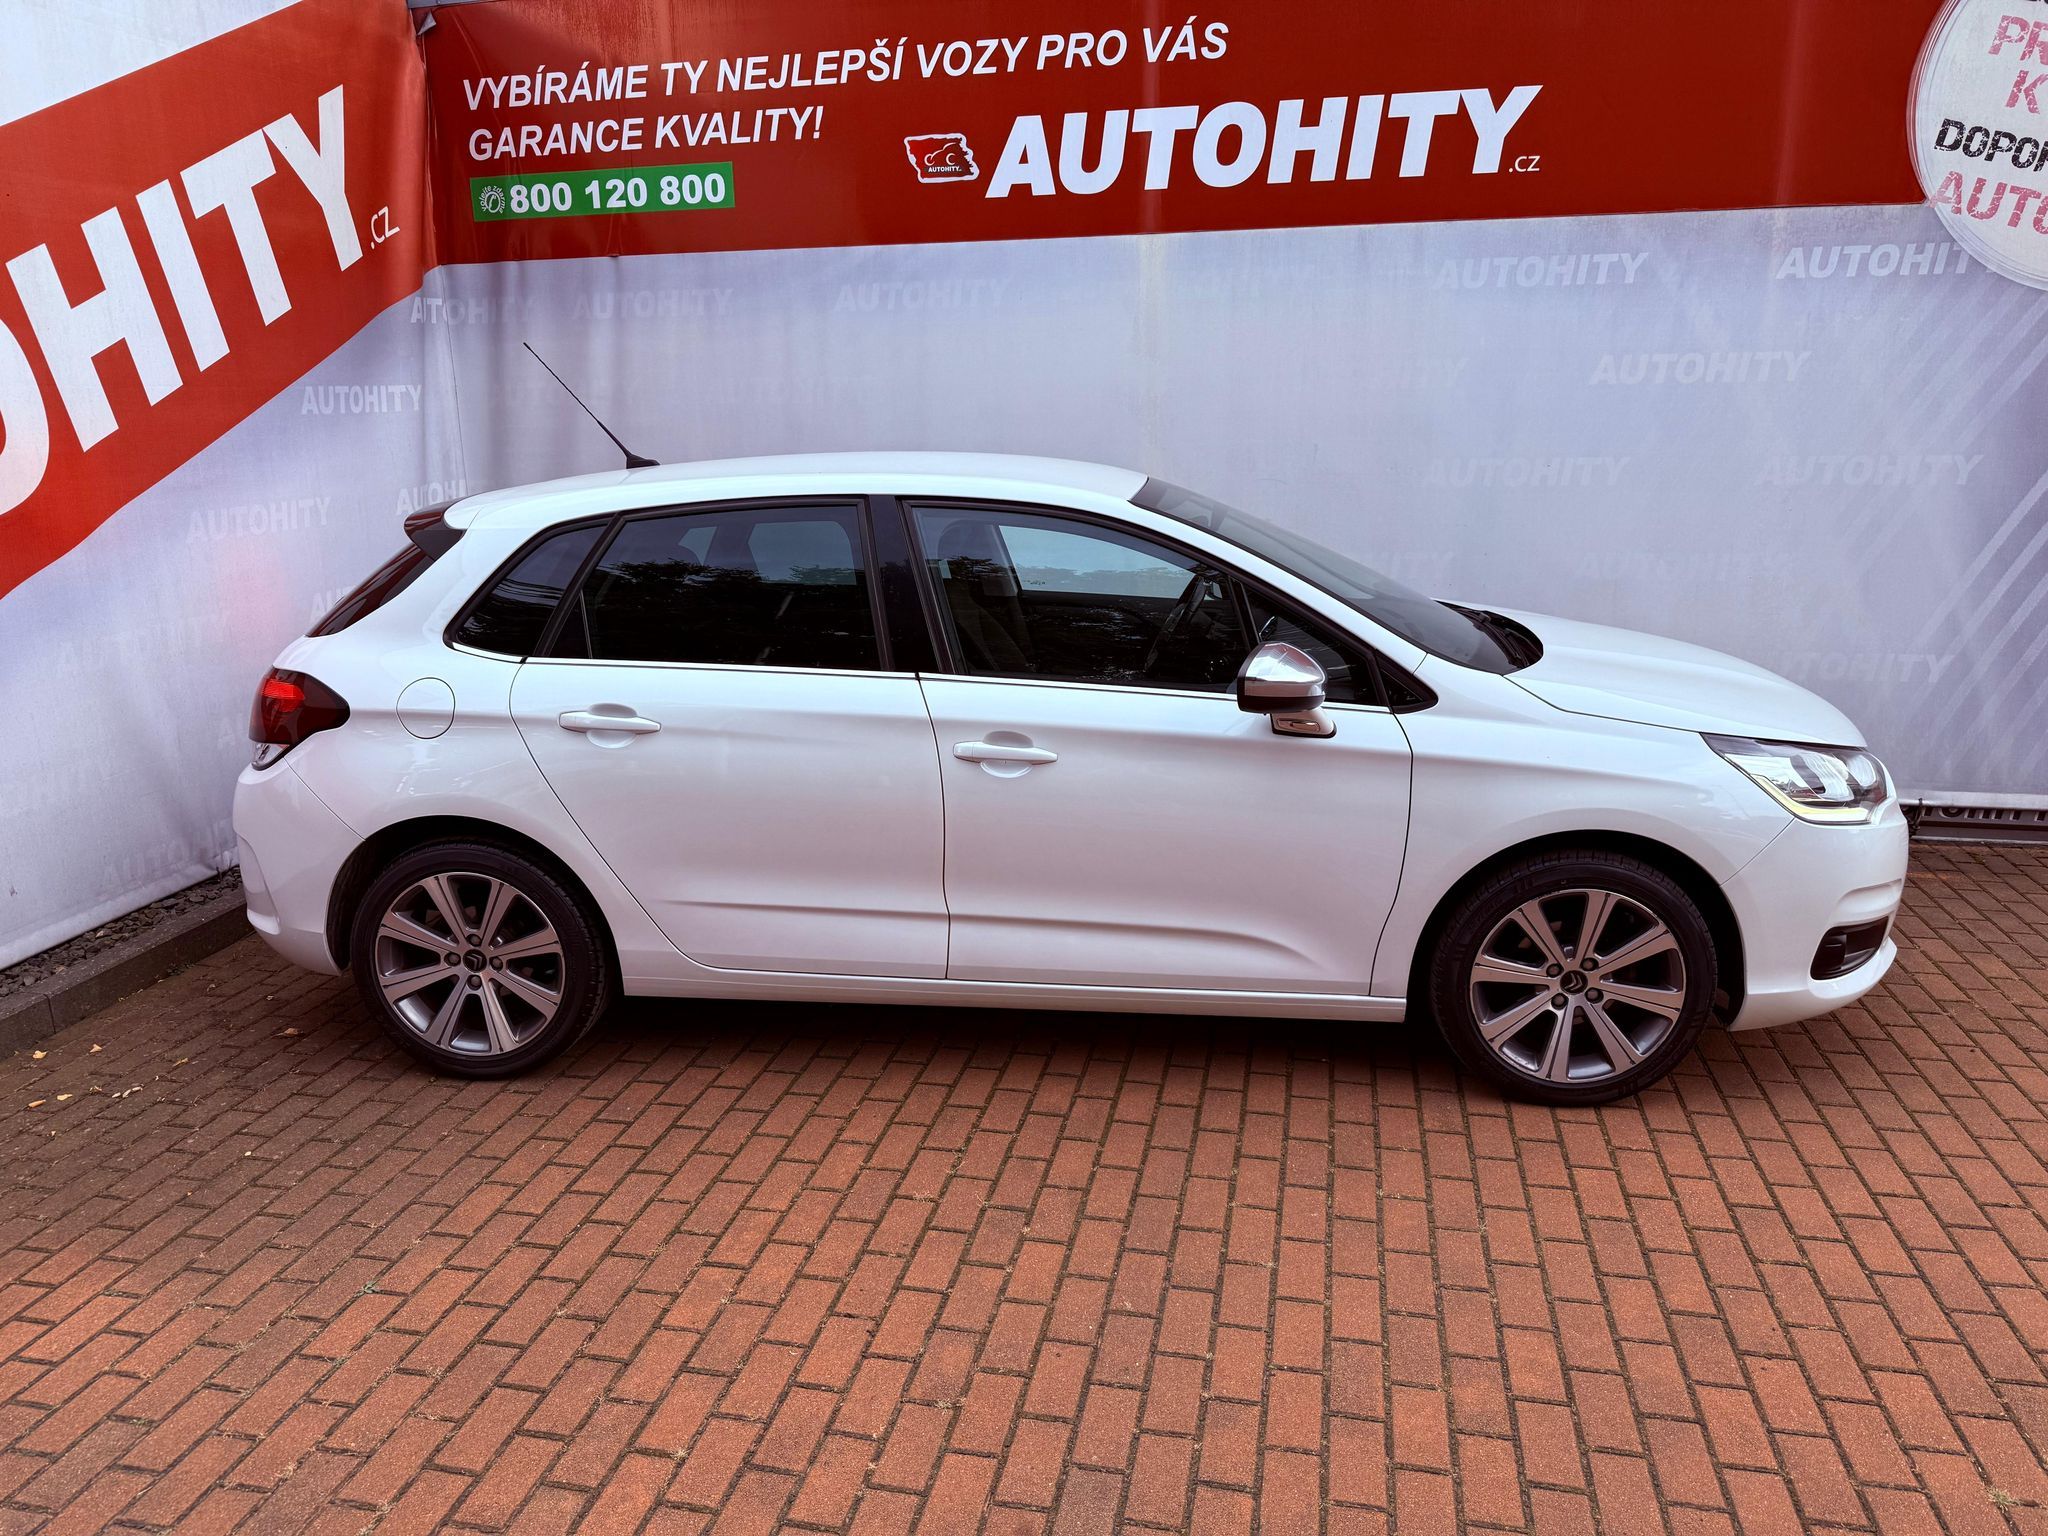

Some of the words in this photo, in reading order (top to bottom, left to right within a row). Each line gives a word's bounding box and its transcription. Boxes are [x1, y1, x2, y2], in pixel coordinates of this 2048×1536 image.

[464, 61, 648, 110] VYBÍRÁME
[661, 60, 708, 95] TY
[717, 37, 907, 92] NEJLEPŠÍ
[917, 37, 1028, 77] VOZY
[1037, 30, 1127, 70] PRO
[1143, 16, 1228, 62] VÁS
[470, 118, 644, 160] GARANCE
[655, 106, 823, 148] KVALITY!
[985, 85, 1543, 198] AUTOHITY
[510, 182, 572, 213] 800
[585, 177, 647, 209] 120
[660, 173, 726, 205] 800
[1431, 252, 1649, 290] AUTOHITY
[1776, 242, 2000, 280] AUTOHIT
[1588, 350, 1814, 386] AUTOHITY
[301, 384, 423, 416] AUTOHITY
[1755, 454, 1985, 487] AUTOHITY
[186, 496, 331, 543] AUTOHITY
